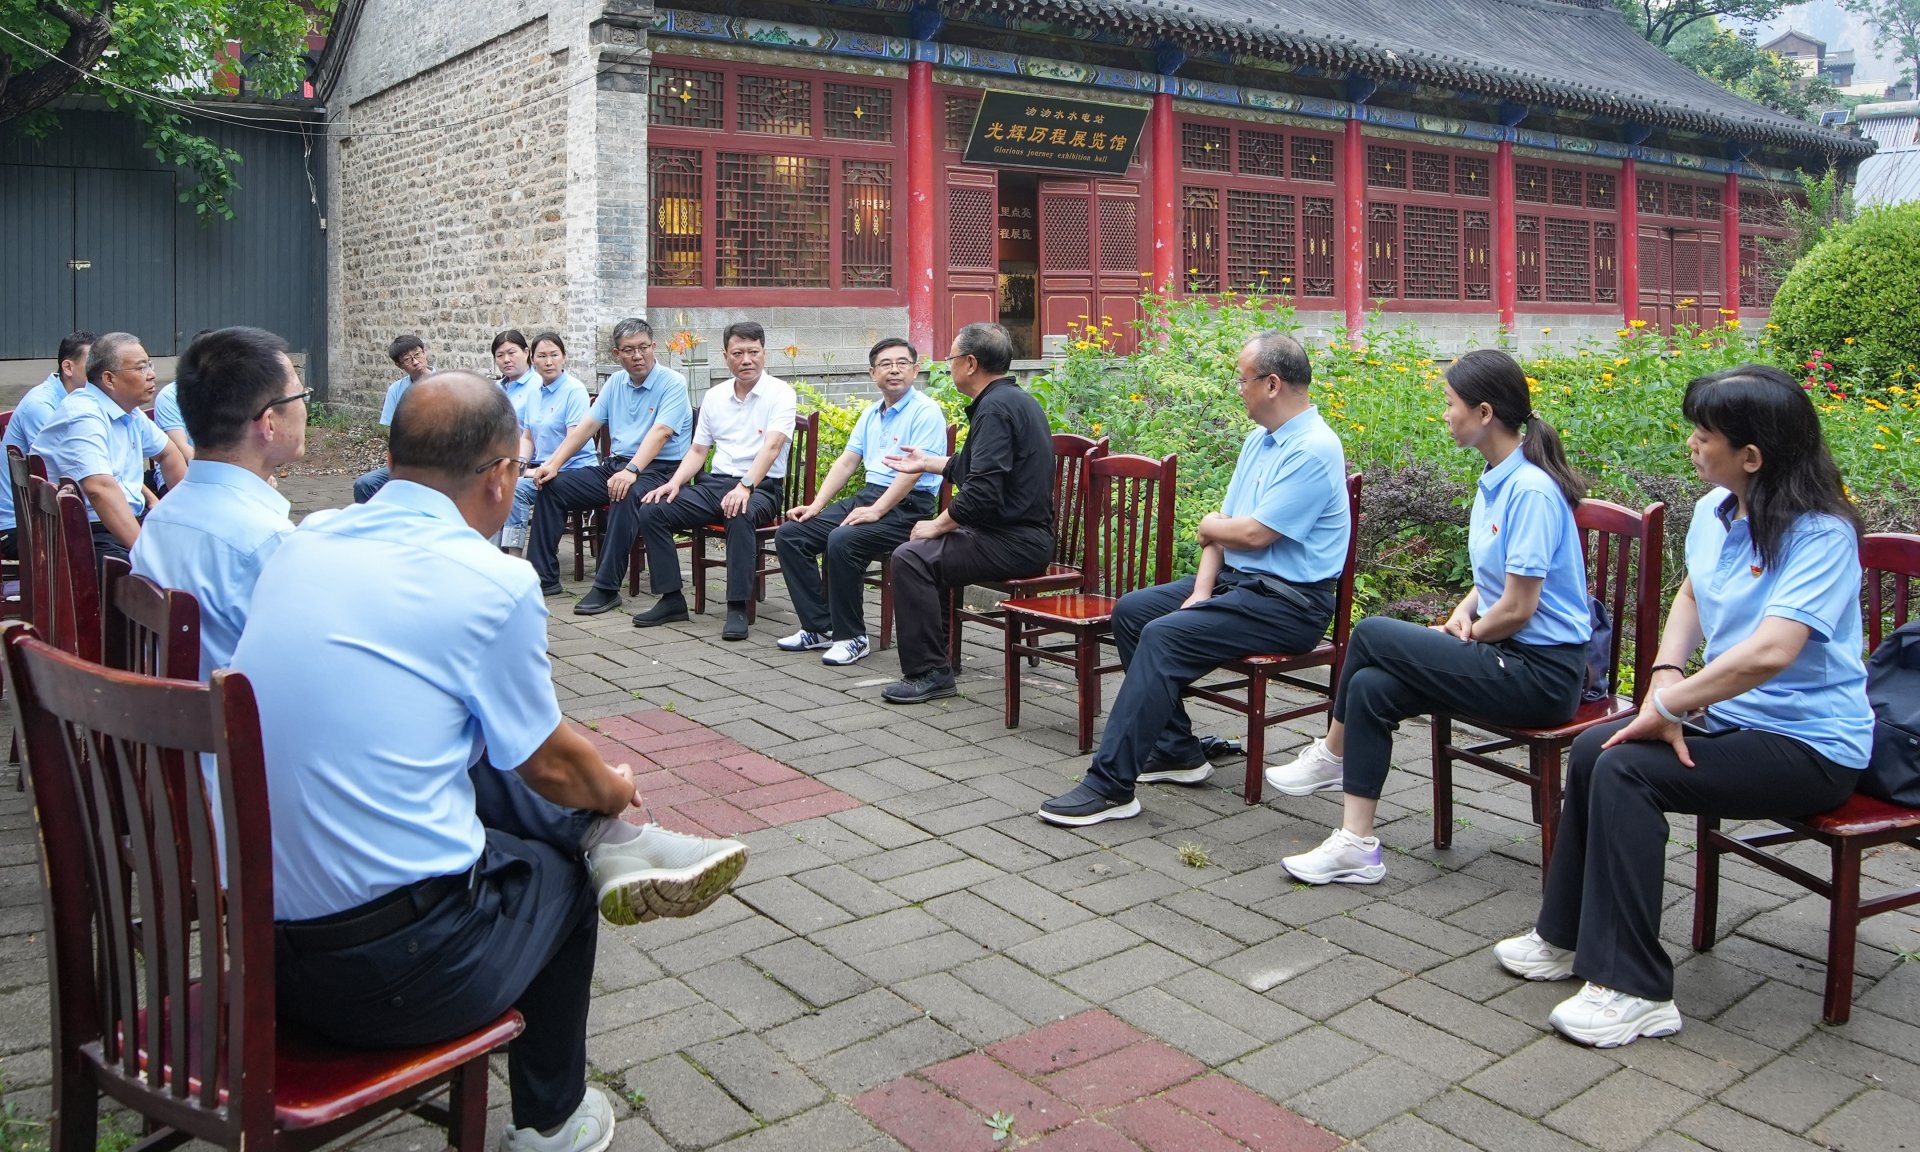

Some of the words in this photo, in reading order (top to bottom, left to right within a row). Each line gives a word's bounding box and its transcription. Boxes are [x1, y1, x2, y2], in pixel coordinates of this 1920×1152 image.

[984, 121, 1128, 152] 光辉历程展览馆
[993, 145, 1024, 156] Glorious
[1026, 148, 1054, 159] journey
[1057, 152, 1091, 162] exhibition
[1094, 155, 1108, 163] hall
[998, 206, 1032, 219] 里点亮
[998, 228, 1032, 241] 程展览
